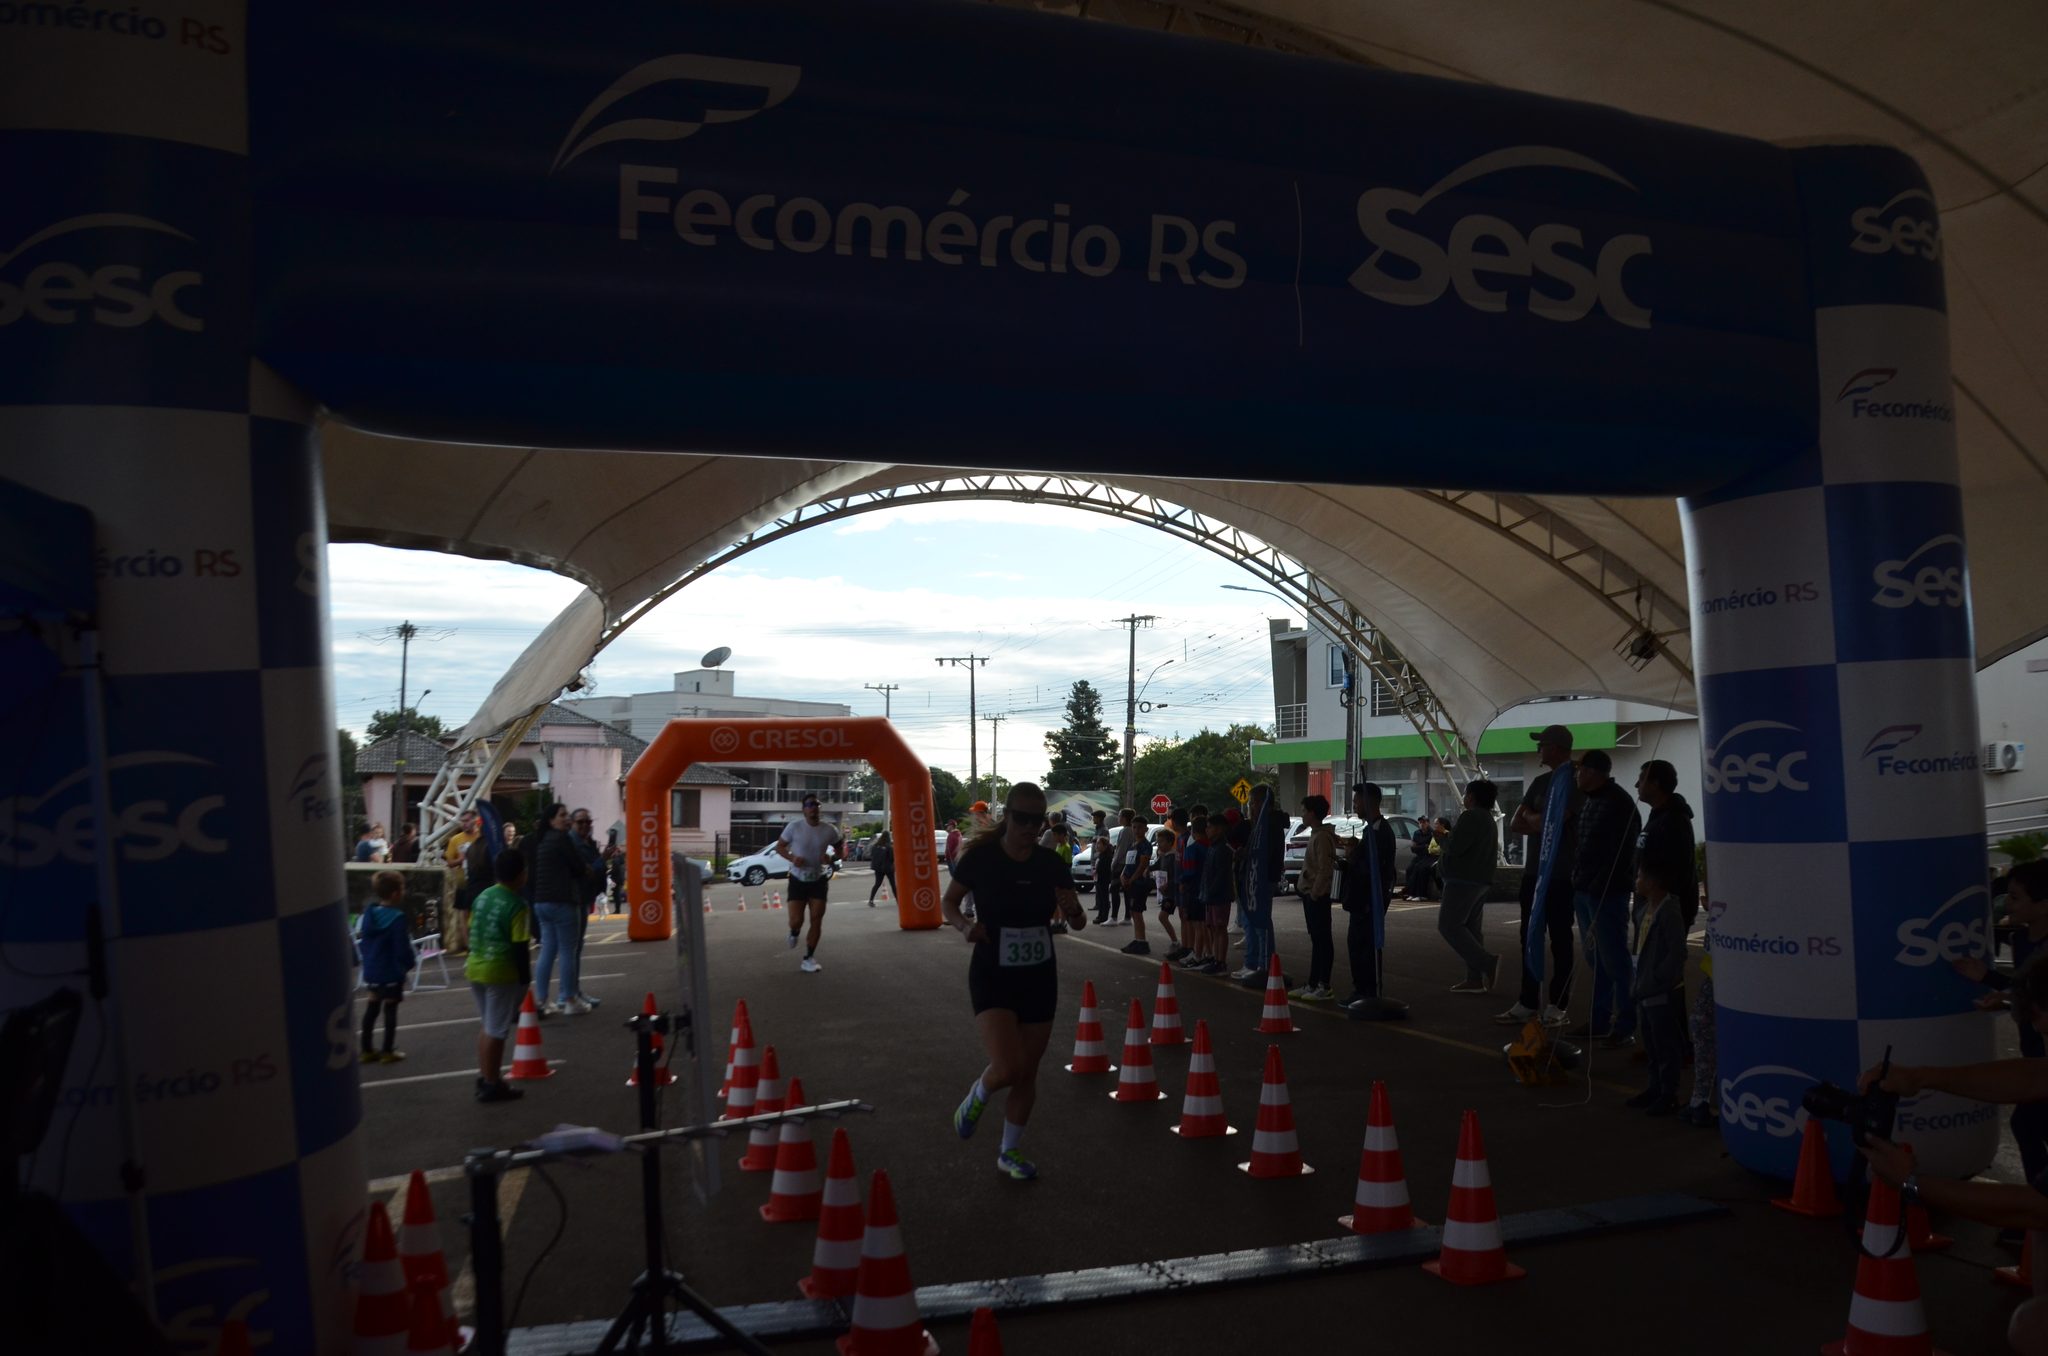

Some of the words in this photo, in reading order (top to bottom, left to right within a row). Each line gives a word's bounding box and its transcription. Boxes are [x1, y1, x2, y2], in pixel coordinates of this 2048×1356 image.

[181, 16, 231, 55] RS
[618, 162, 1122, 278] Fecomércio
[1147, 212, 1249, 289] RS
[1347, 187, 1654, 330] Sesc
[195, 548, 242, 578] RS
[1784, 582, 1819, 602] RS
[747, 727, 854, 750] CRESOL
[0, 794, 229, 868] Sesc
[641, 803, 660, 893] CRESOL
[909, 792, 932, 881] CRESOL
[1007, 941, 1044, 962] 339
[1807, 936, 1842, 956] RS
[231, 1053, 278, 1087] RS
